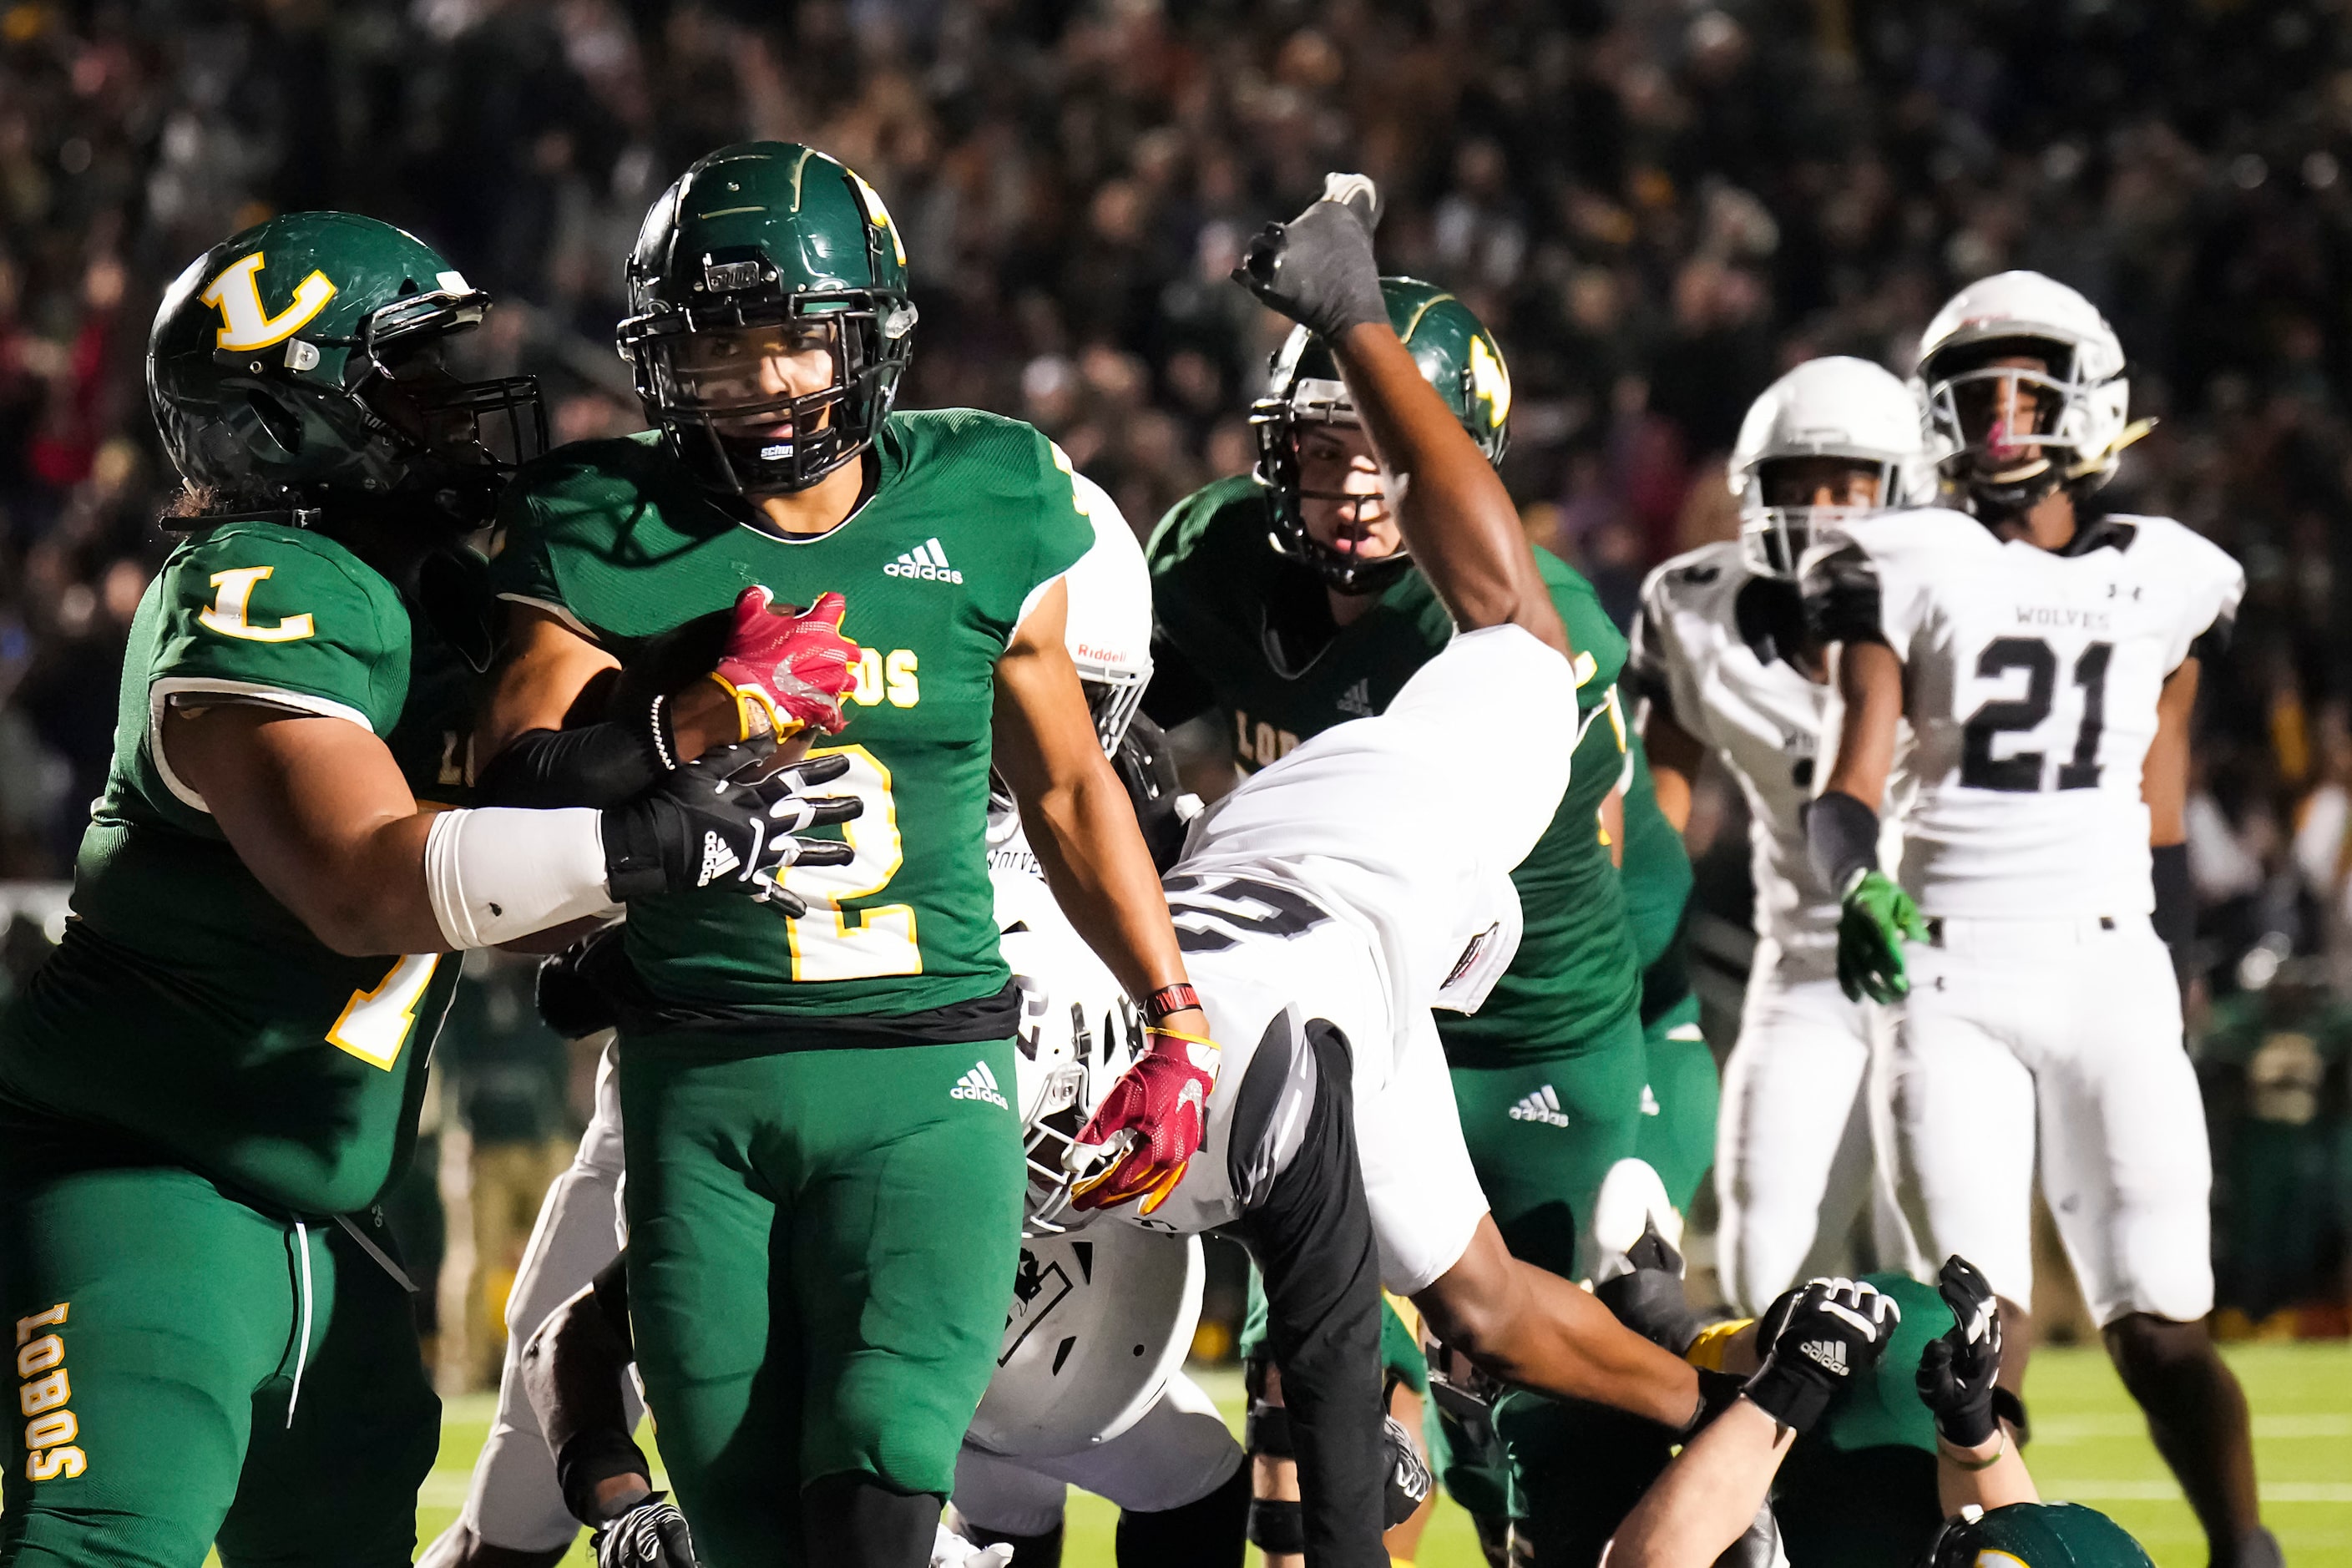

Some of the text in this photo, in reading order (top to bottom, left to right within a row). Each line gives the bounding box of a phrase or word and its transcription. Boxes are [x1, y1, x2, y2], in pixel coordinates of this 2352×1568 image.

[200, 251, 338, 352] L
[883, 561, 964, 584] adidas
[199, 566, 315, 643] L
[2016, 607, 2111, 630] WOLVES
[1077, 643, 1127, 663] Riddell
[1958, 635, 2115, 794] 21
[696, 831, 718, 888] adidas
[776, 744, 923, 983] 2
[950, 1083, 1009, 1110] adidas
[1509, 1105, 1570, 1127] adidas
[1800, 1342, 1850, 1377] adidas
[17, 1302, 88, 1482] LOBOS
